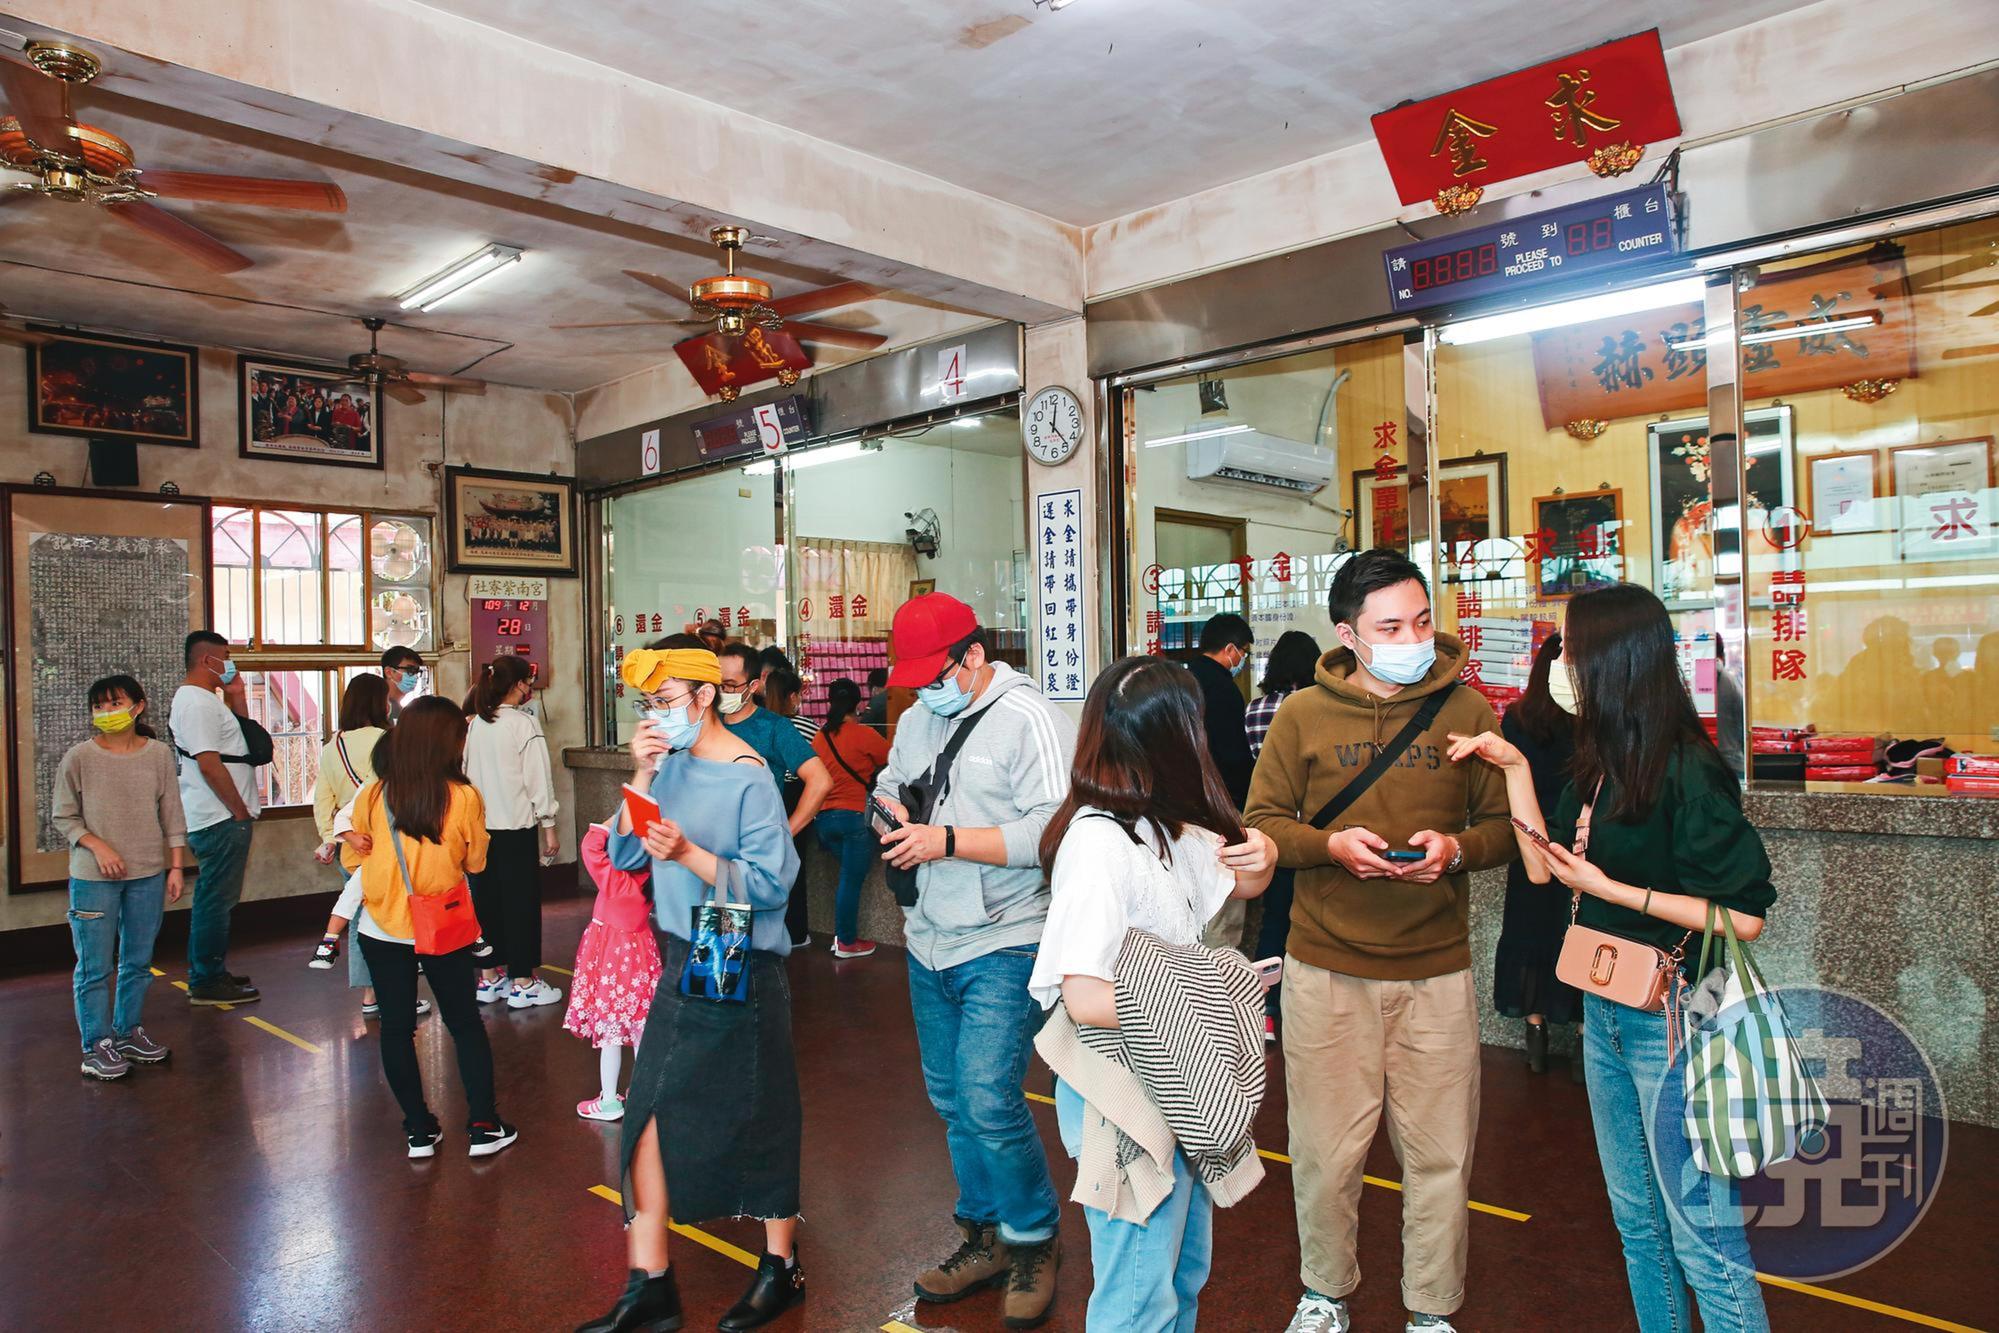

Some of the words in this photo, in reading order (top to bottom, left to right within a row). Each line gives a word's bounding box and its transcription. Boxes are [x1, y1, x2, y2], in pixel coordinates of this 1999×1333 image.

[1430, 69, 1620, 177] 求金
[1391, 256, 1407, 272] 請
[1501, 232, 1519, 248] 號
[1541, 222, 1558, 239] 到
[1618, 232, 1663, 252] COUNTER
[1515, 248, 1548, 263] PLEASE
[1505, 260, 1544, 277] PROCEED
[1550, 256, 1562, 267] TO
[1399, 289, 1413, 300] NO.
[944, 352, 964, 396] 4
[1041, 401, 1047, 410] 11
[1050, 394, 1058, 405] 12
[1034, 411, 1043, 421] 10
[1069, 405, 1075, 416] 2
[759, 410, 780, 450] 5
[1031, 424, 1037, 435] 9
[1072, 418, 1079, 429] 3
[1034, 437, 1040, 447] 8
[1070, 431, 1076, 440] 4
[645, 435, 657, 470] 6
[1041, 446, 1047, 455] 7
[1051, 448, 1058, 458] 6
[1373, 421, 1399, 512] 求金單
[1930, 497, 1979, 540] 求
[485, 601, 501, 610] 109
[520, 601, 529, 611] 12
[829, 594, 867, 619] 還金
[497, 619, 521, 635] 28
[635, 613, 662, 634] 還金
[1772, 571, 1807, 681] 請排隊
